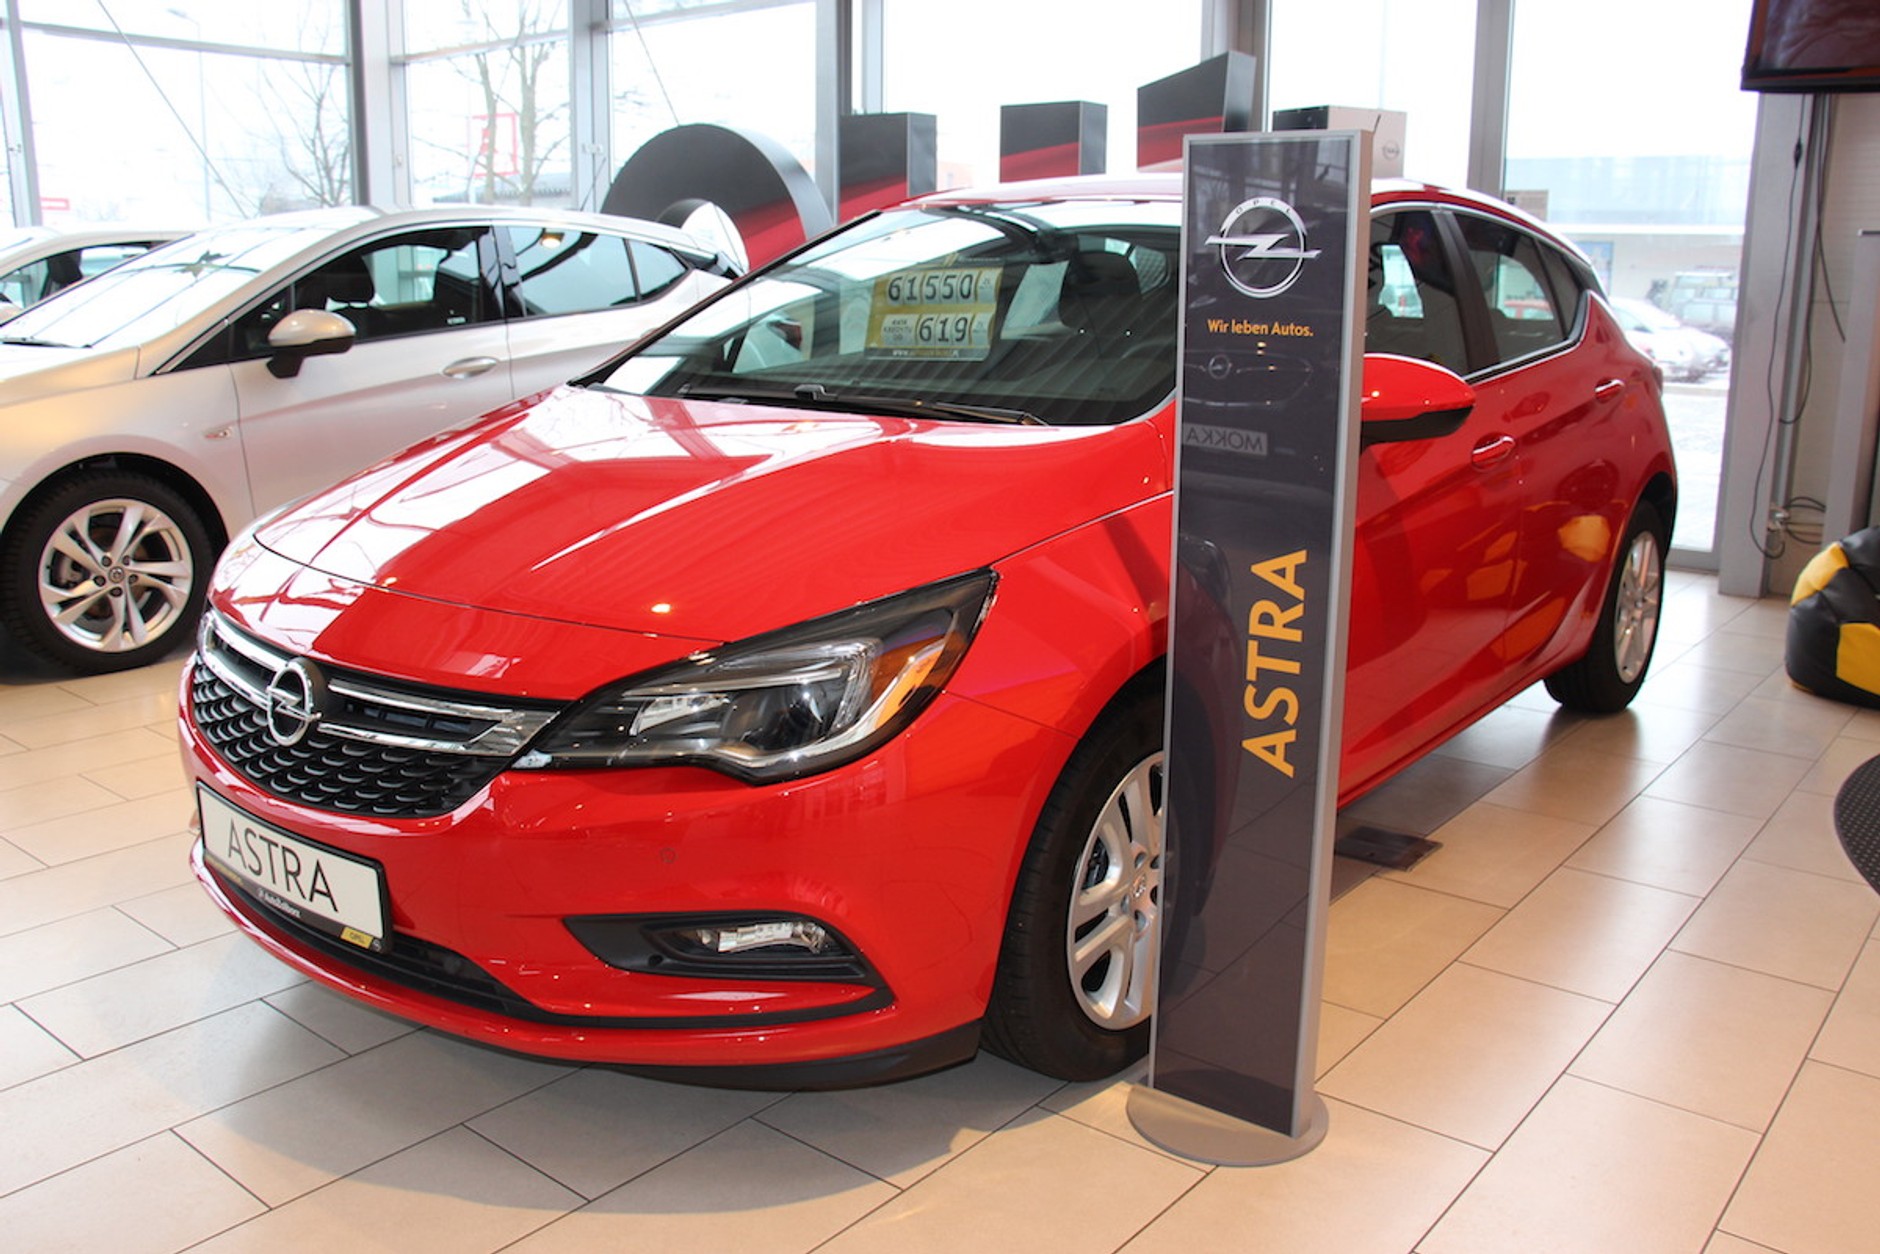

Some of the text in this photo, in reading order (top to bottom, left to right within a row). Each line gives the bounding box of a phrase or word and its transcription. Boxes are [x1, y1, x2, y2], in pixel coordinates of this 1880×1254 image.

[919, 317, 968, 342] 619
[1207, 319, 1314, 336] Wir leben Autos.
[1241, 549, 1308, 779] ASTRA
[228, 817, 339, 913] ASTRA
